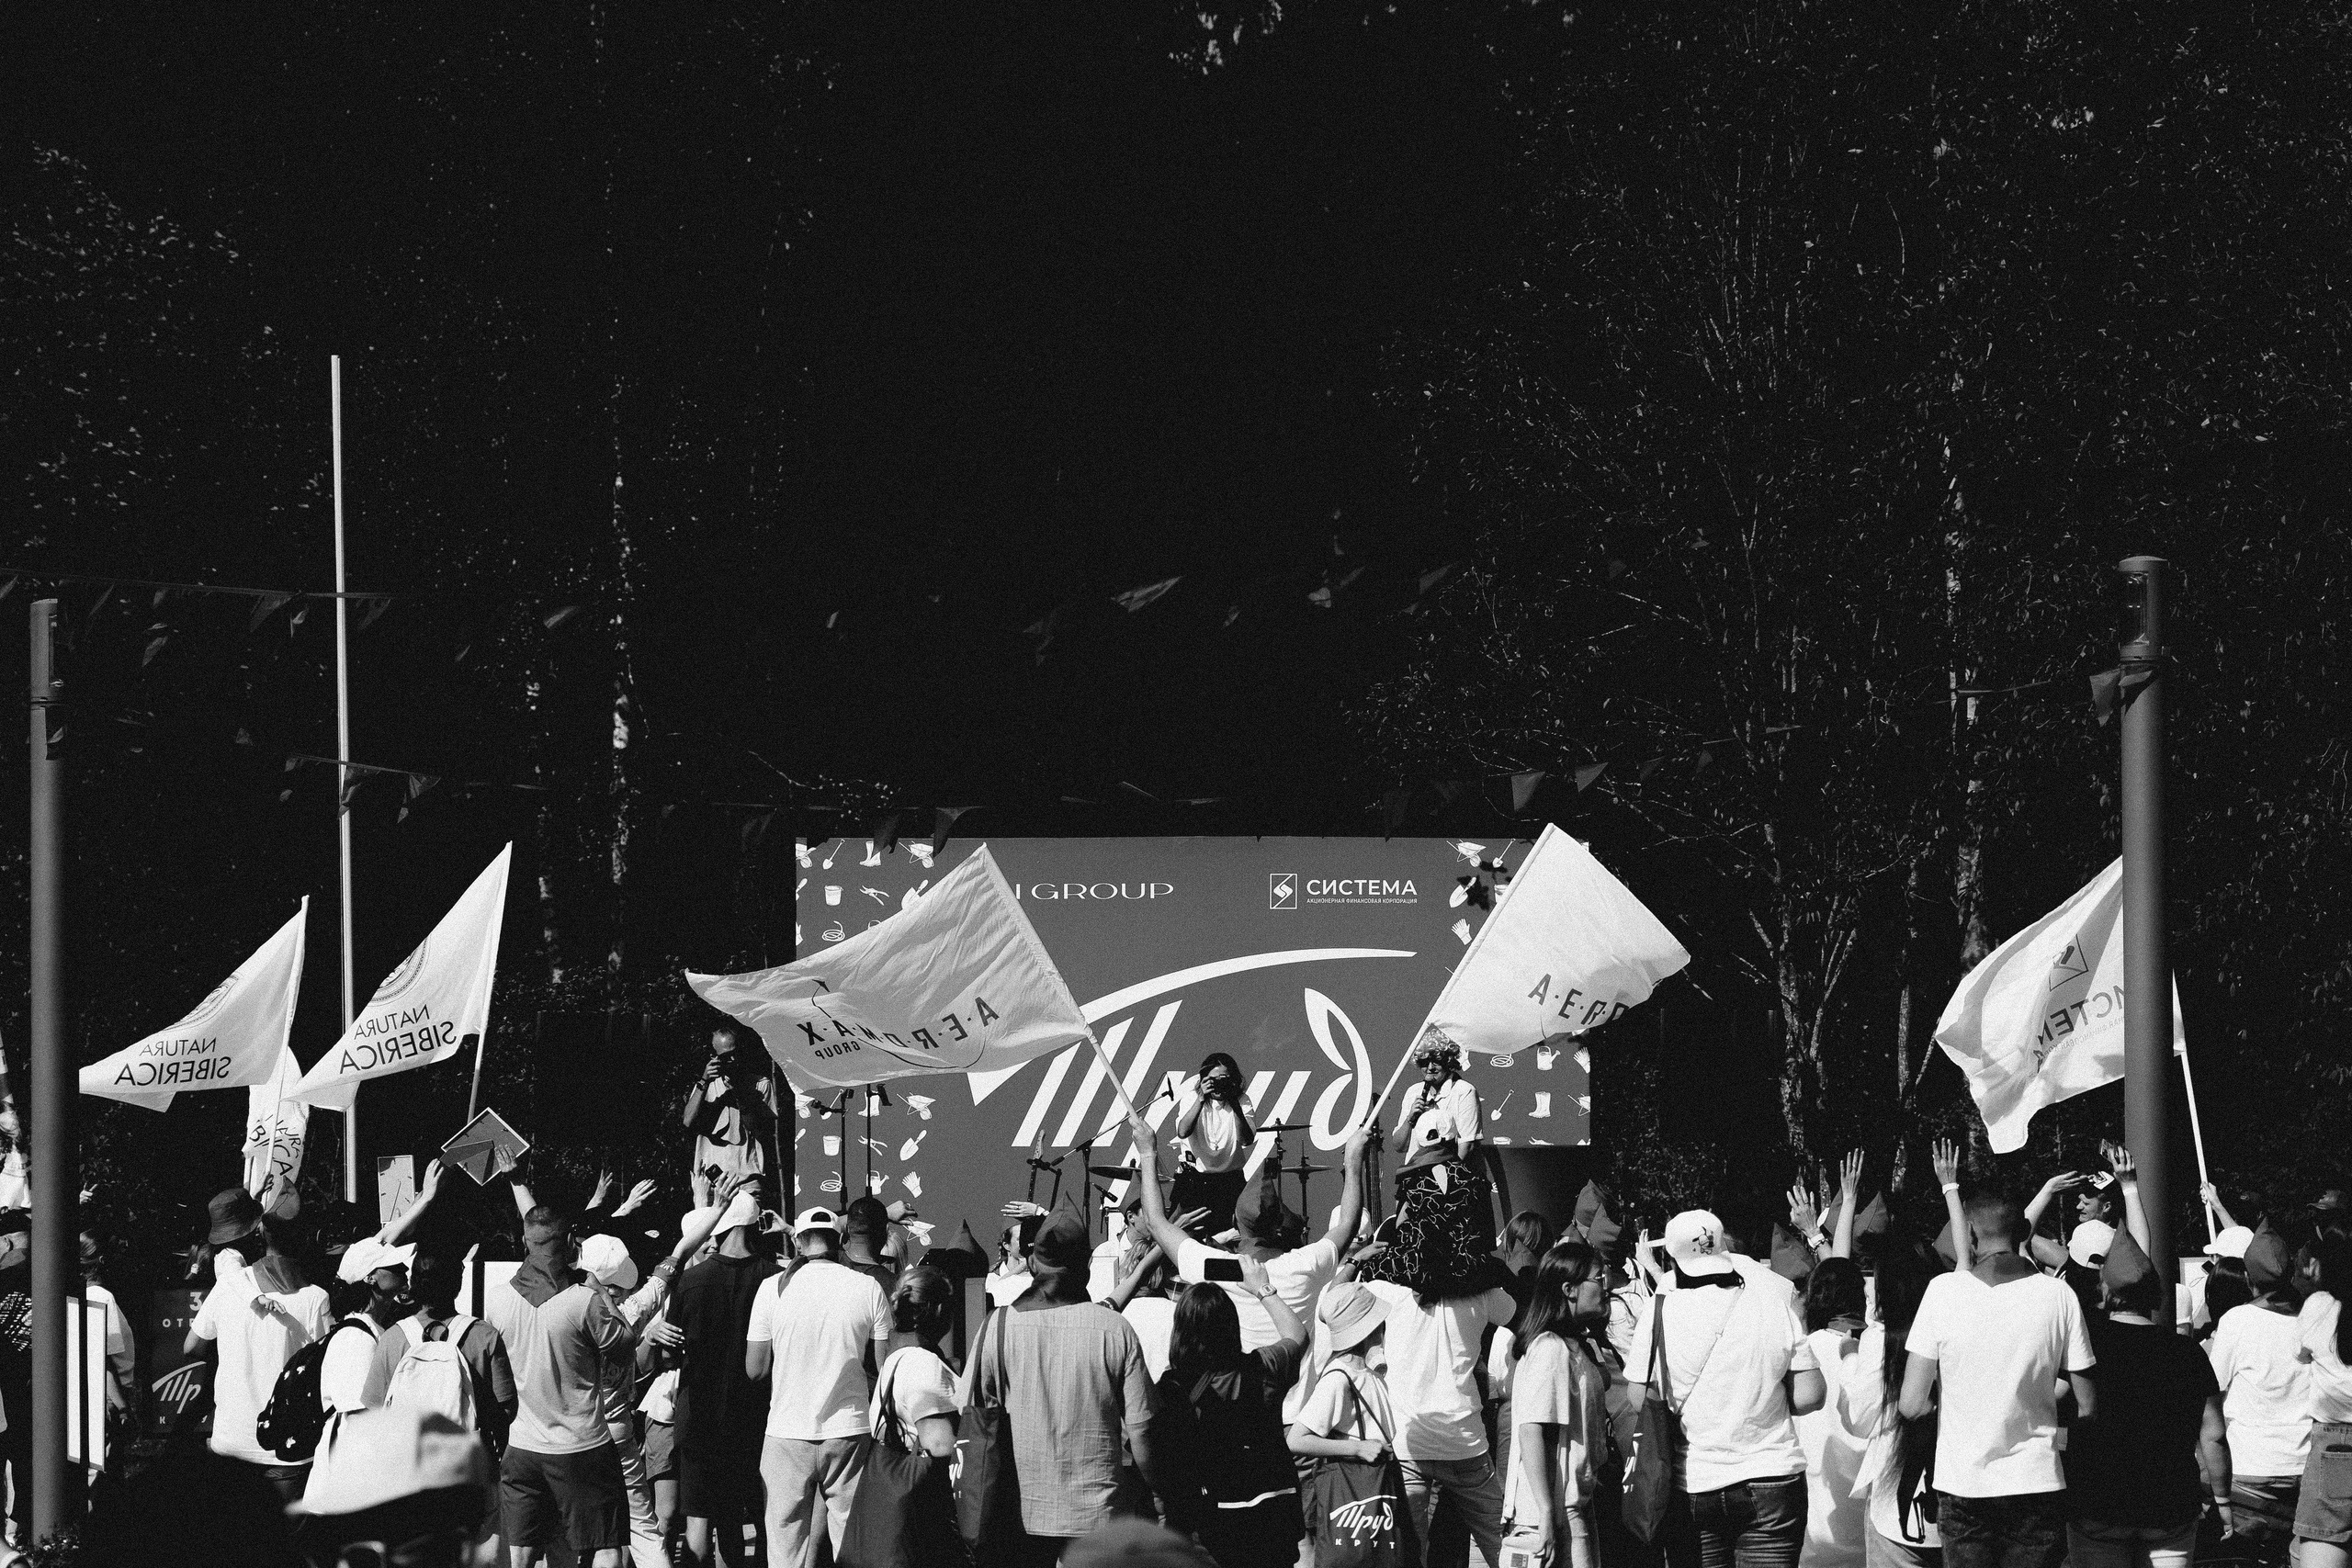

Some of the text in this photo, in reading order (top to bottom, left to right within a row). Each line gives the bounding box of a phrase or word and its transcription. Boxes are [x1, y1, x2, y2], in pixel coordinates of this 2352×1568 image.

[1031, 883, 1174, 900] GROUP
[1306, 879, 1418, 896] СИСТЕМА
[1329, 1495, 1397, 1539] Труд
[1335, 1538, 1396, 1550] КРУТ
